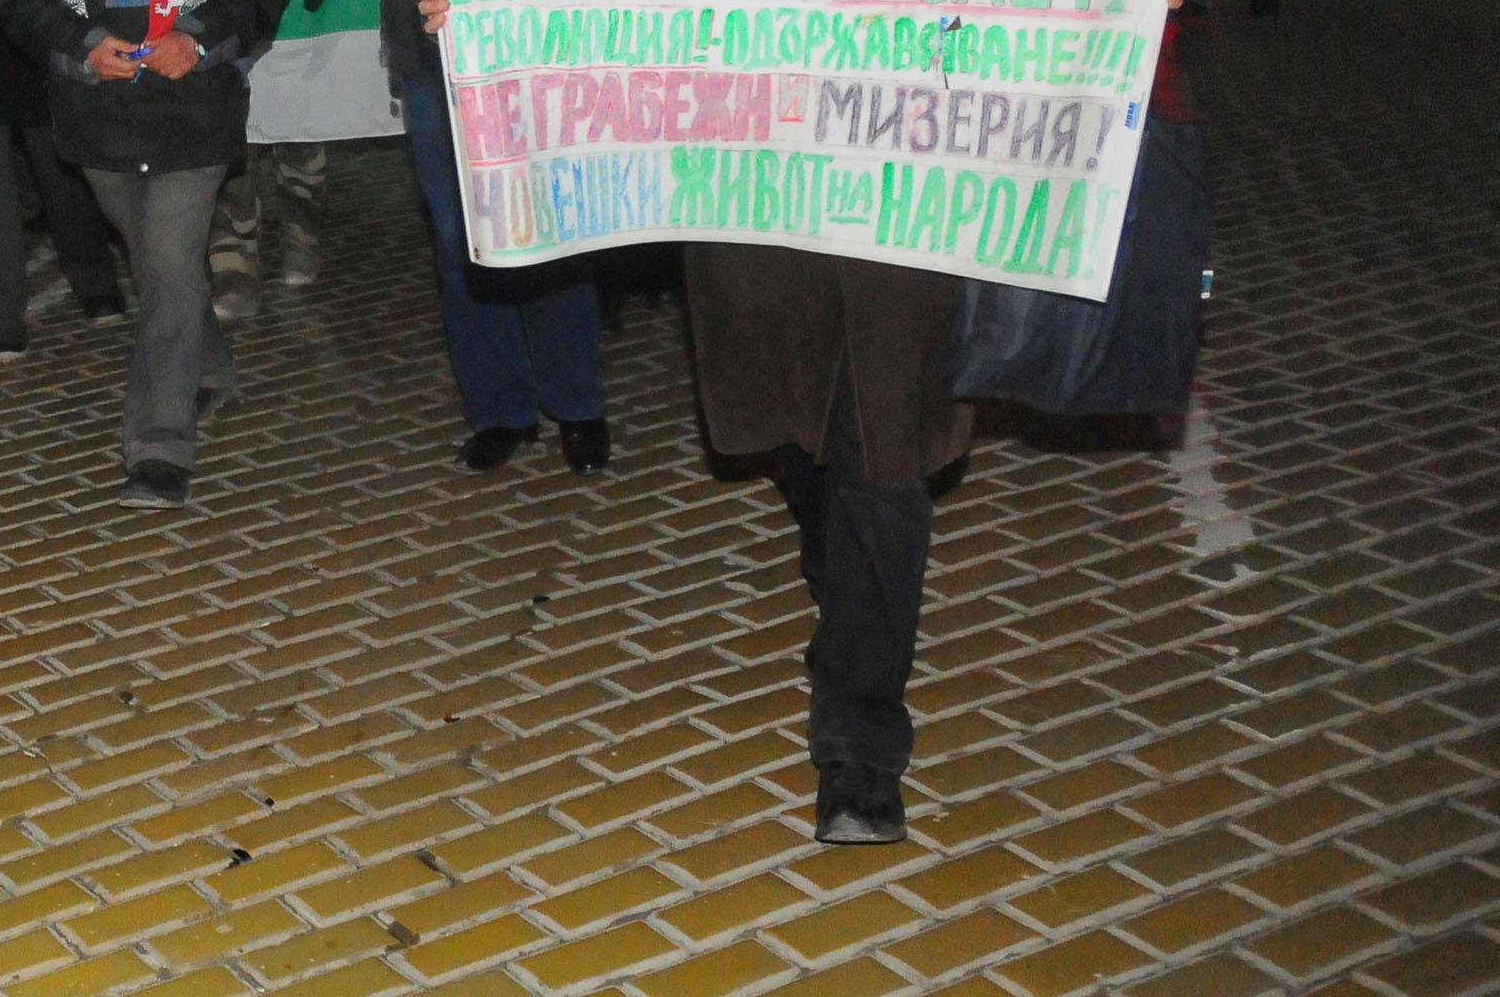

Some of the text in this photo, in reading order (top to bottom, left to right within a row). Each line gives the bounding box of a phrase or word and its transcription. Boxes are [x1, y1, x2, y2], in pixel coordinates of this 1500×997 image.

[530, 71, 772, 151] ГРАБЕЖИ
[814, 79, 1115, 171] МИЗЕРИЯ!
[472, 152, 663, 249] ЧОВЕШКИ
[667, 145, 834, 236] ЖИВОТ
[874, 161, 1120, 279] НАРОДА!
